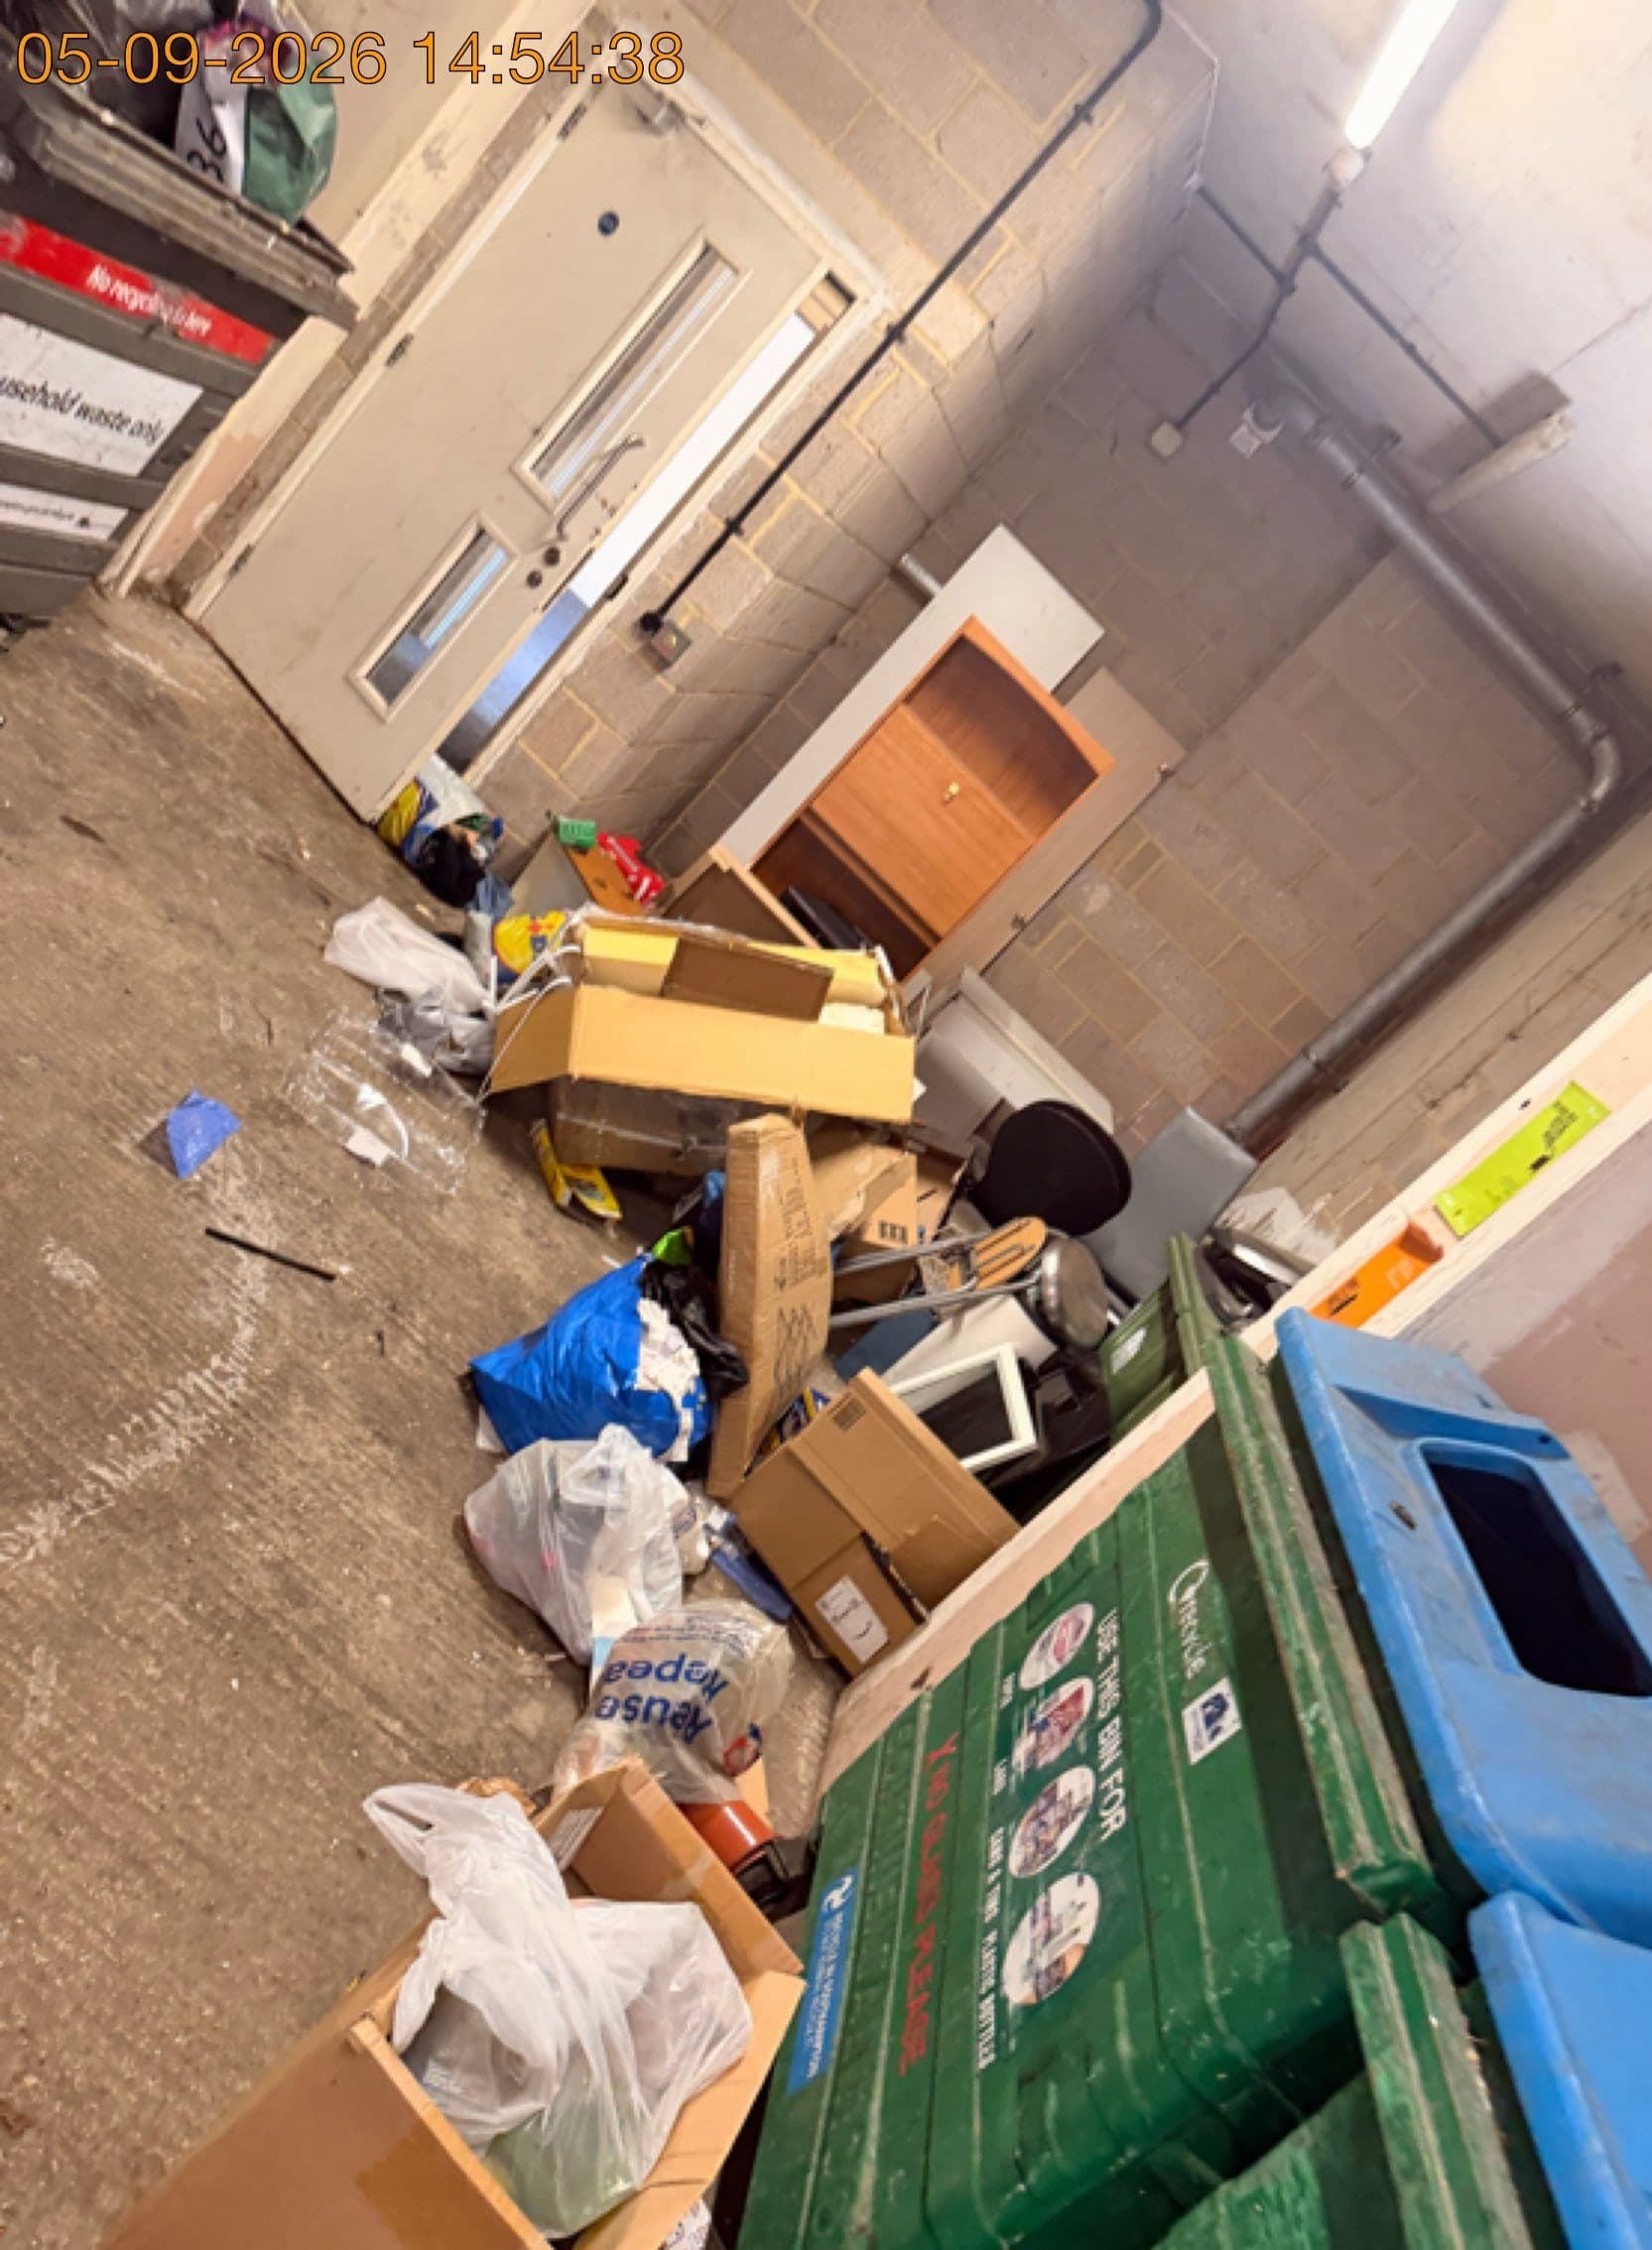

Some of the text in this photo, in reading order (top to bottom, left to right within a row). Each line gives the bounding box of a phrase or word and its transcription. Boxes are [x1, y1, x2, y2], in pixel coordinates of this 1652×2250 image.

[73, 399, 132, 434] waste
[594, 1692, 713, 1746] Reuse
[1097, 1714, 1123, 1773] BIN
[1097, 1766, 1127, 1843] FOR
